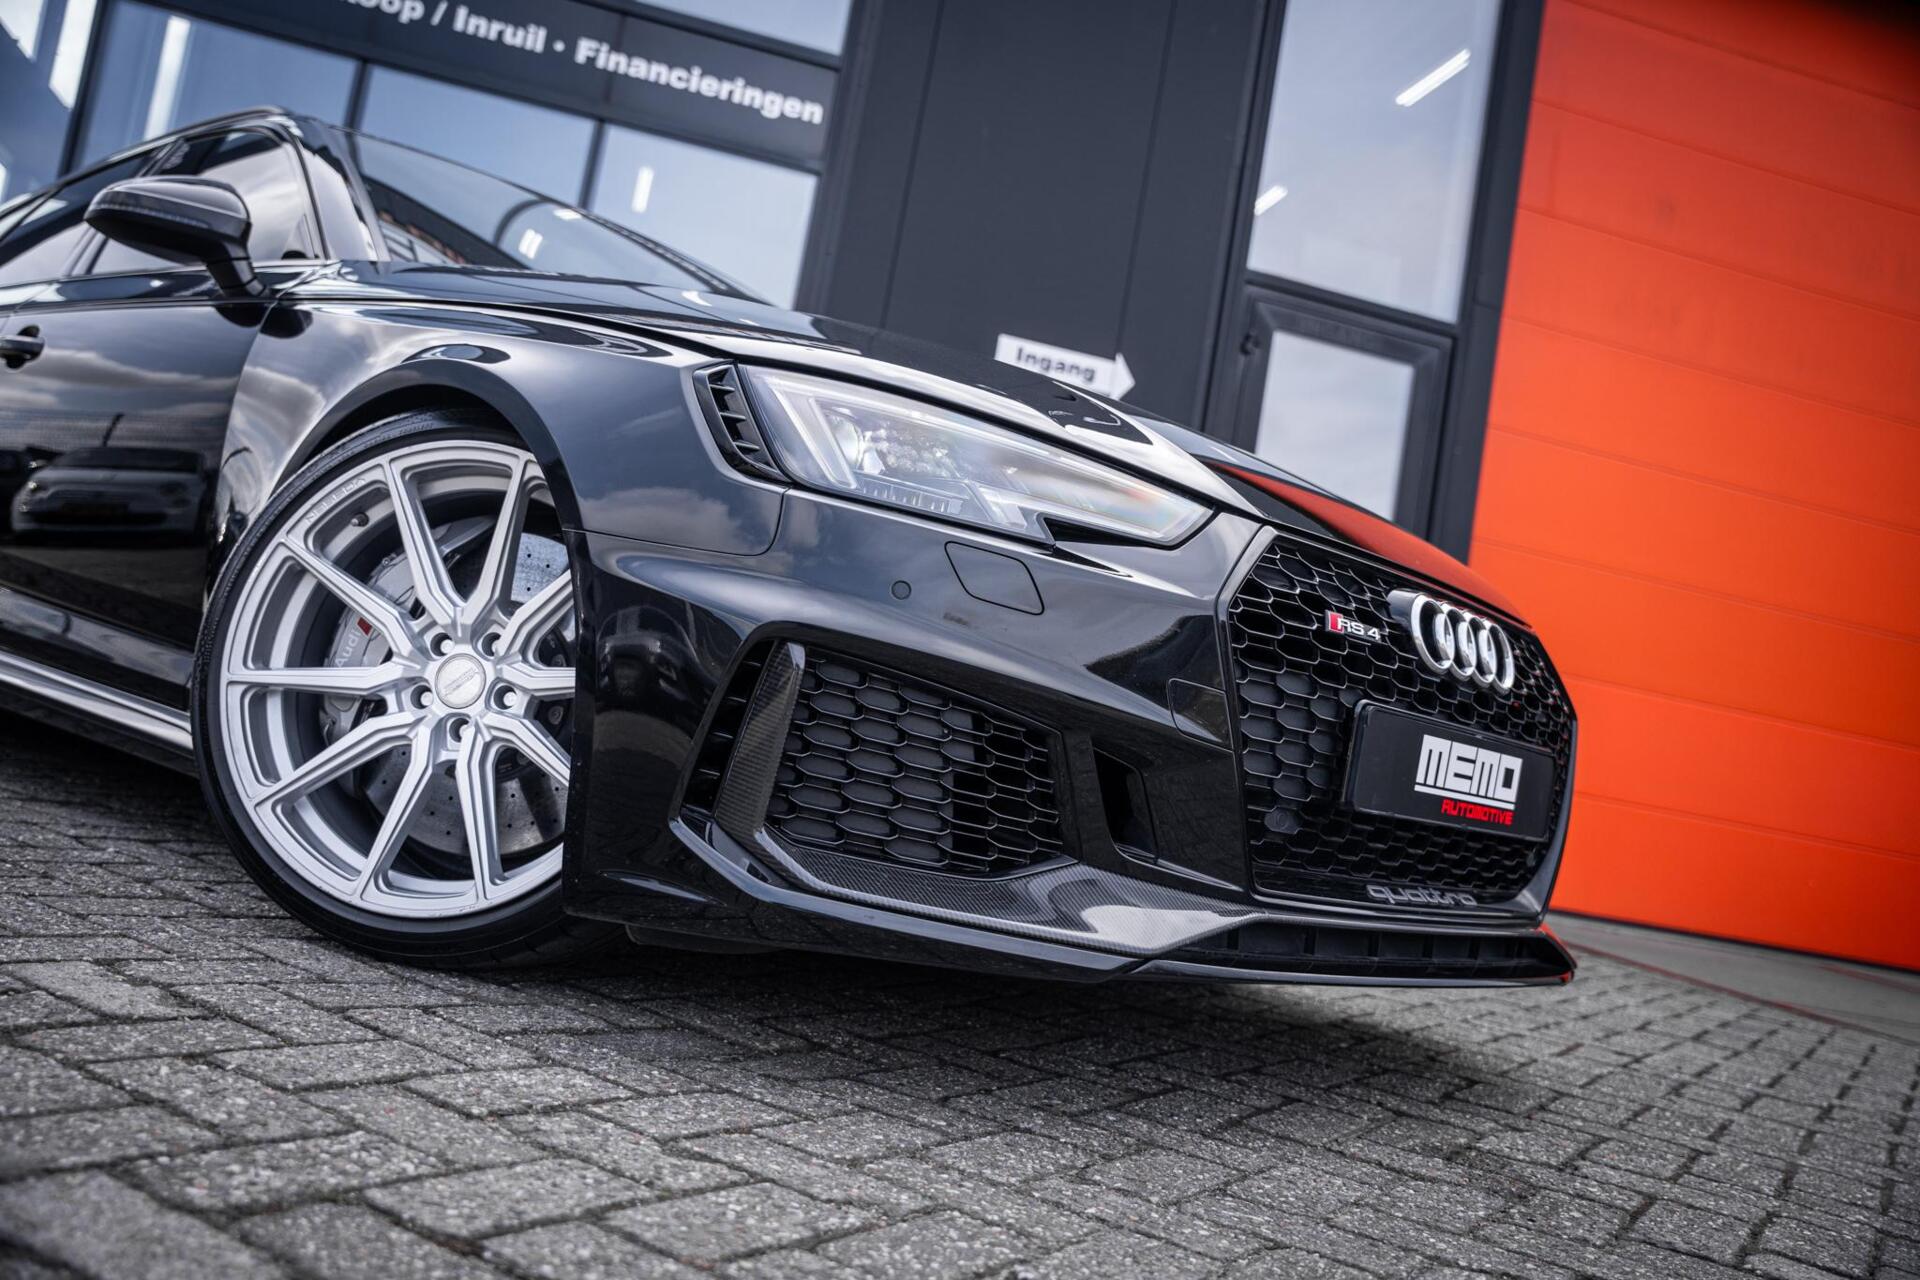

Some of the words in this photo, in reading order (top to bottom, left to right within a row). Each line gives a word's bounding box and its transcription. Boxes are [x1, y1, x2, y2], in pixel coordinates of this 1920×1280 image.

[346, 0, 425, 24] op
[453, 4, 548, 54] Inruil
[574, 36, 824, 125] Financieringen
[1016, 347, 1096, 382] Ingang
[1416, 734, 1523, 803] MEMO
[1441, 799, 1514, 826] AUTOMOTIVE
[1366, 885, 1478, 906] quattro
